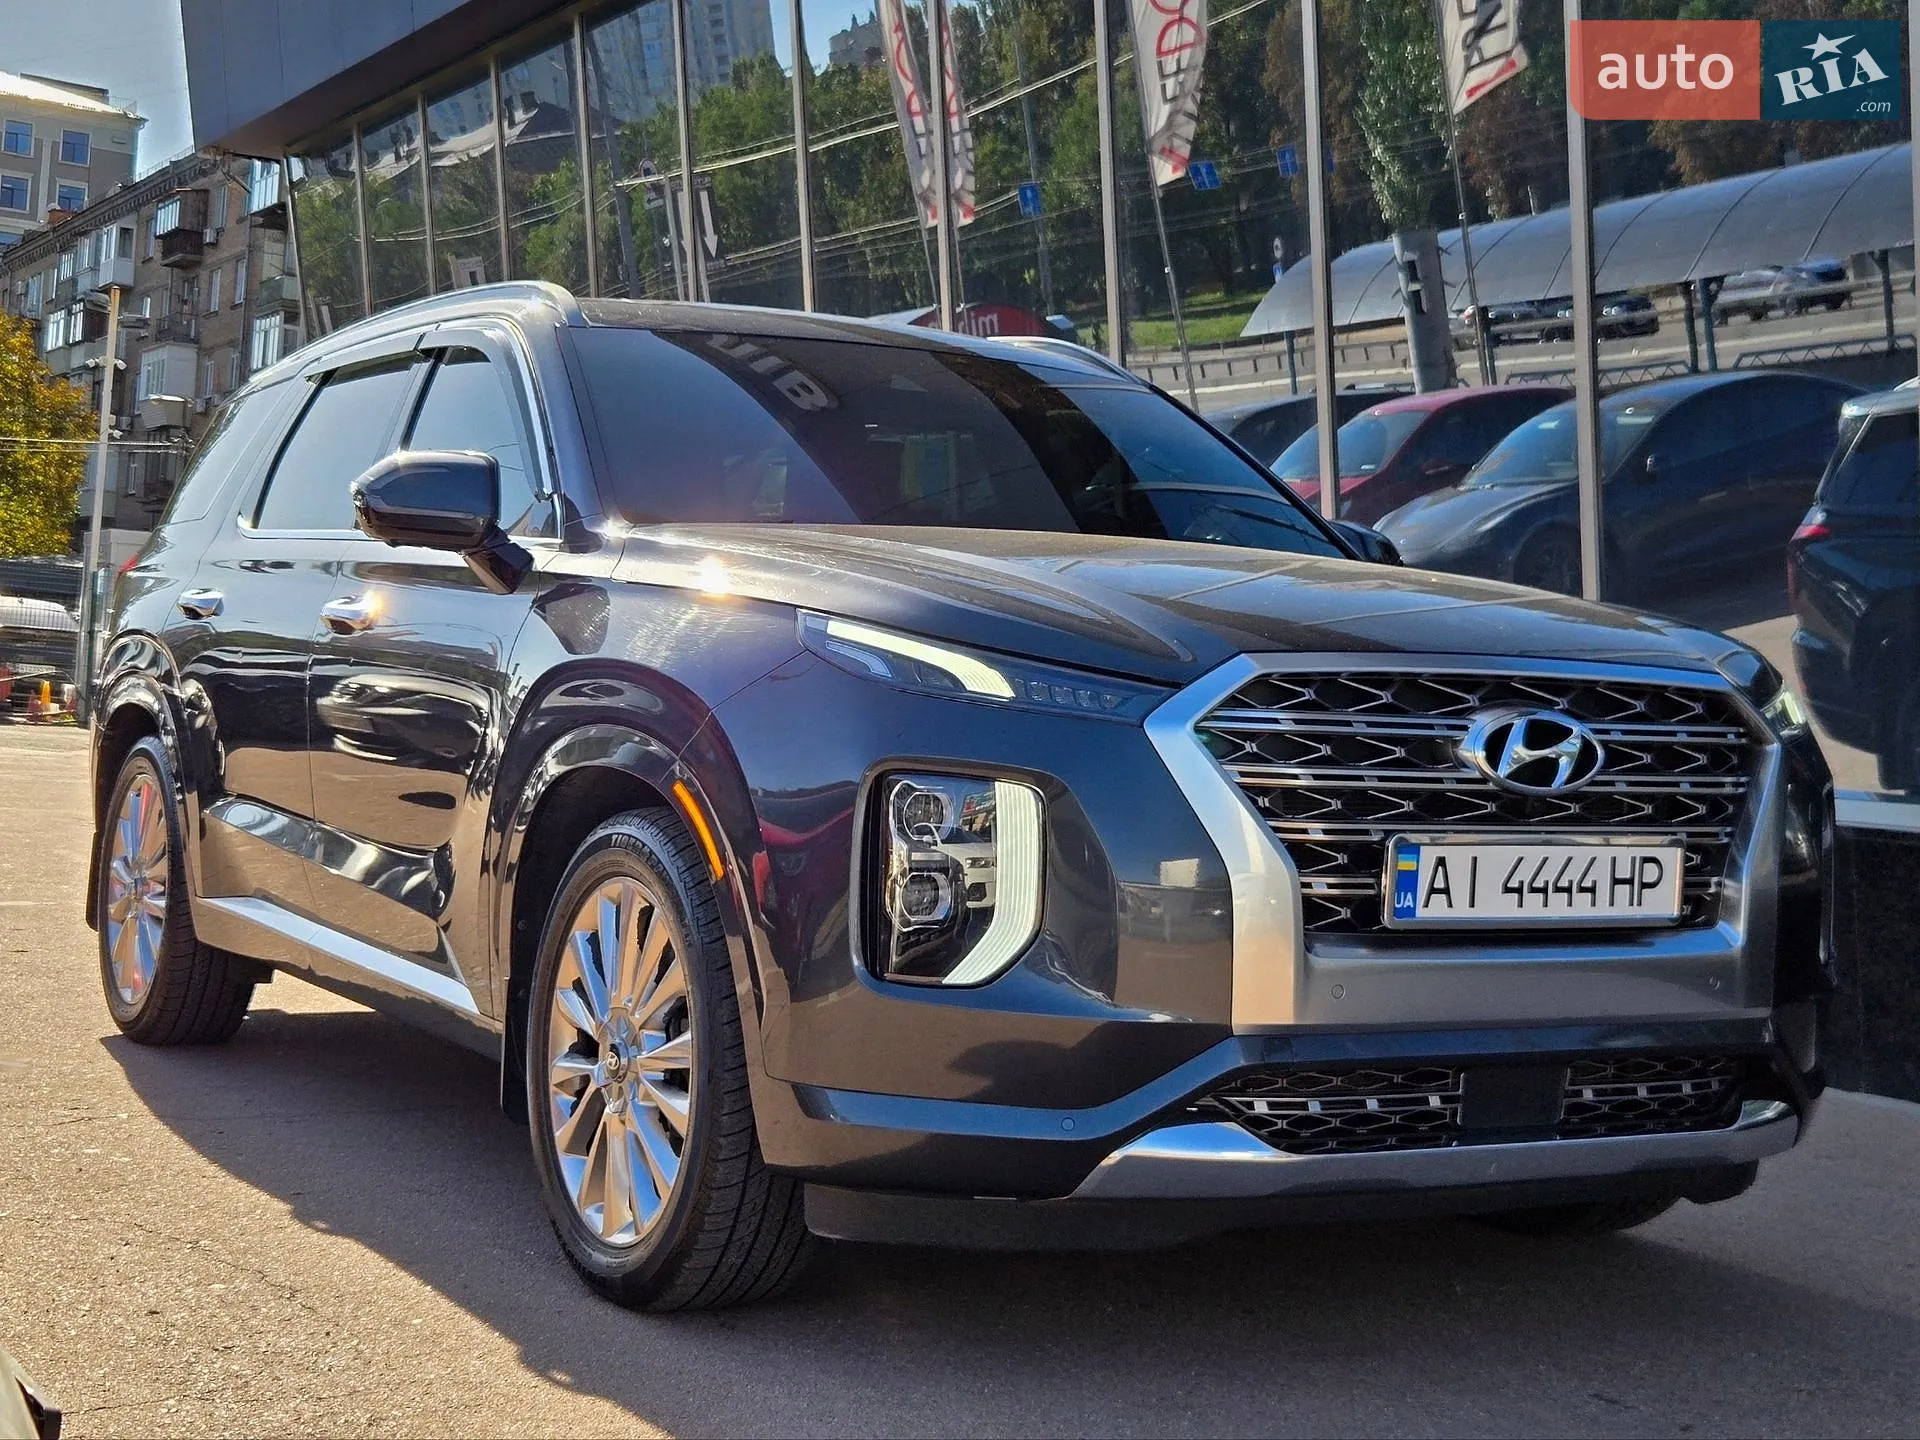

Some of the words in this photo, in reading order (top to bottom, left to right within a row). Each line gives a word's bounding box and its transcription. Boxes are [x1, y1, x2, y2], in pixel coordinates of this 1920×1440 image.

[1501, 855, 1597, 908] 4444
[1608, 855, 1664, 907] HP
[1395, 891, 1414, 908] UA
